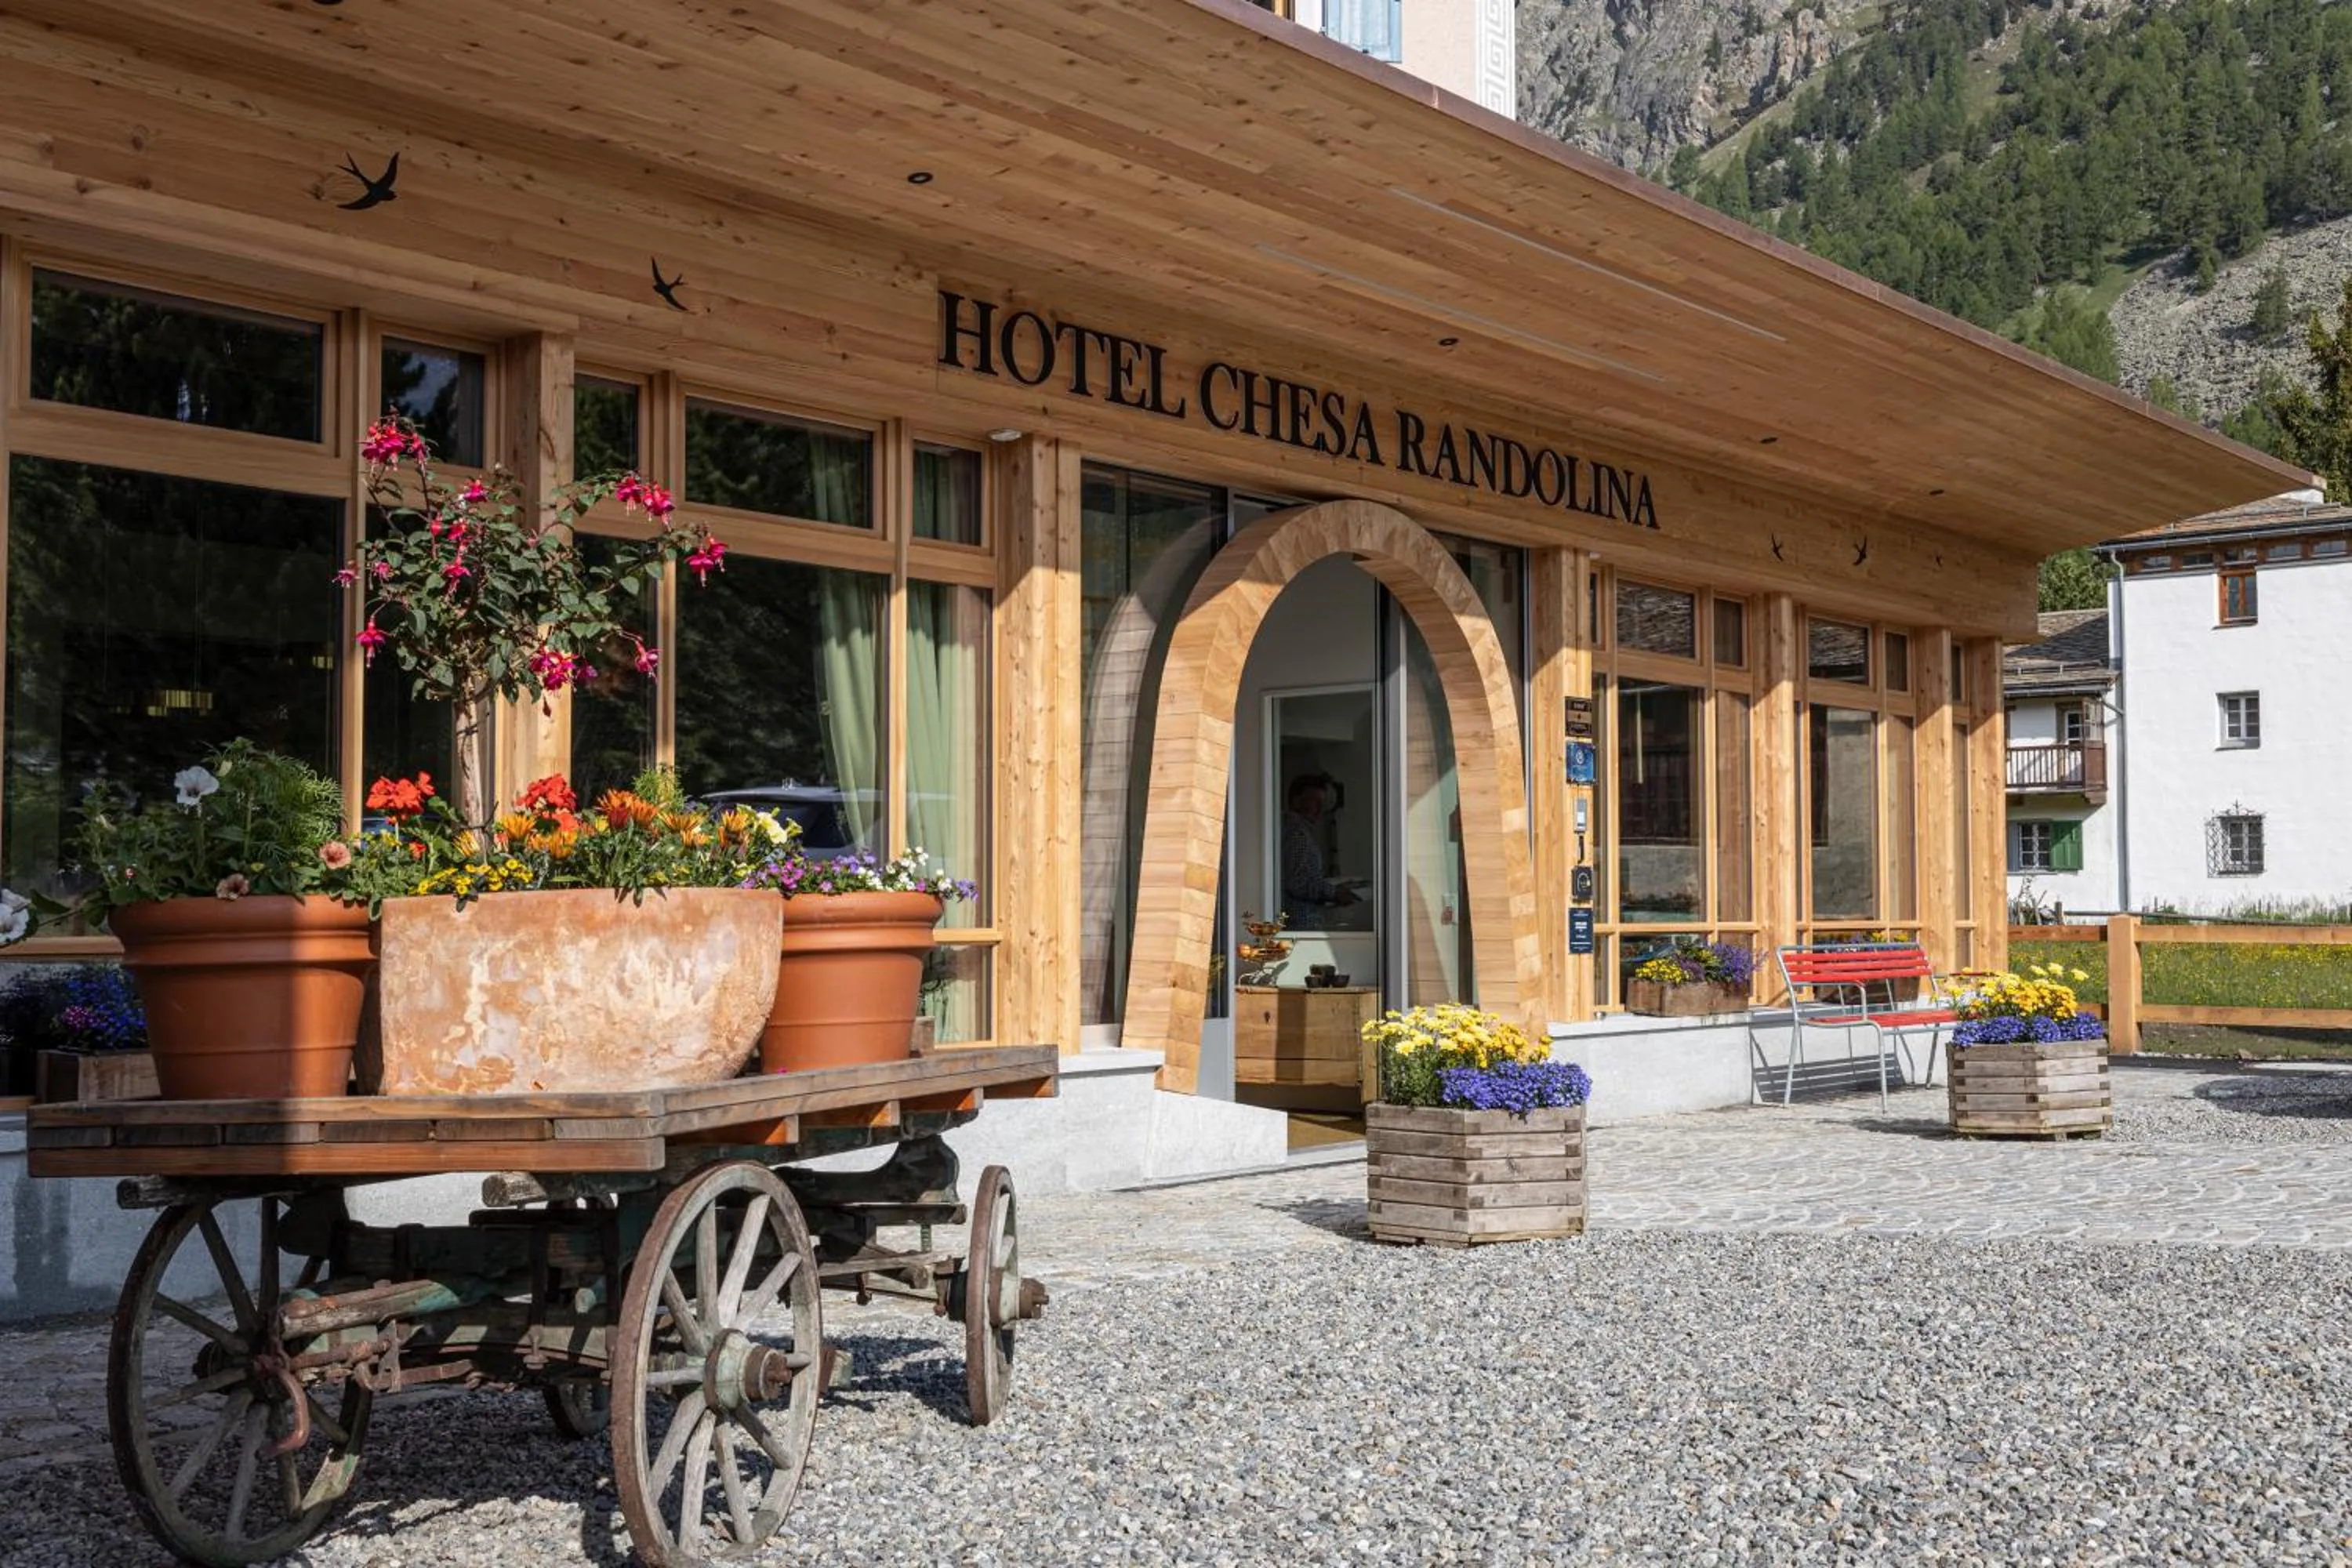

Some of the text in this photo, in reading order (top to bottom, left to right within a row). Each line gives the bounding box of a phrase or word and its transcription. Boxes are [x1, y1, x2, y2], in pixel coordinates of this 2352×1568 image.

[939, 291, 1660, 530] HOTEL CHESA RANDOLINA
